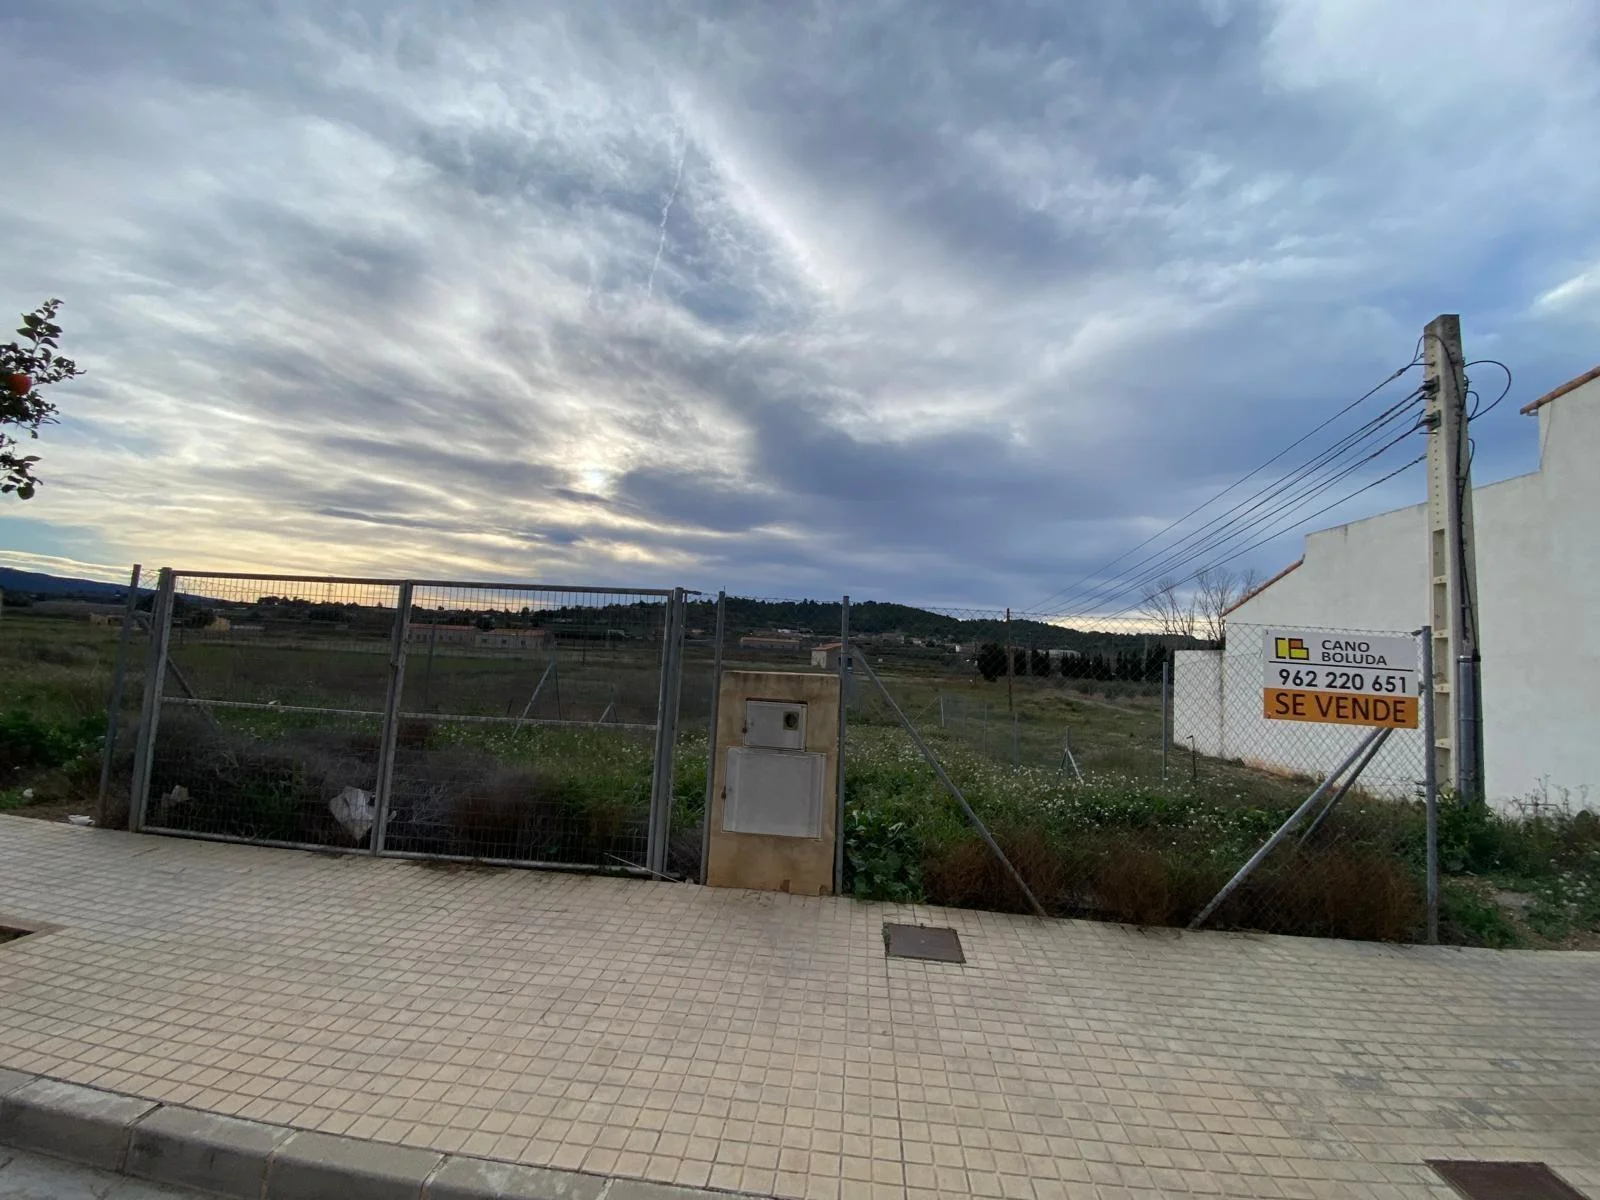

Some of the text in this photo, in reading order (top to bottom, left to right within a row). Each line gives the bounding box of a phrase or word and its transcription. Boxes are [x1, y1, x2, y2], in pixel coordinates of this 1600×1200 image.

[1321, 640, 1370, 653] CANO
[1321, 652, 1388, 666] BOLUDA
[1279, 669, 1406, 693] 962 220 651
[1275, 692, 1406, 723] SE VENDE
